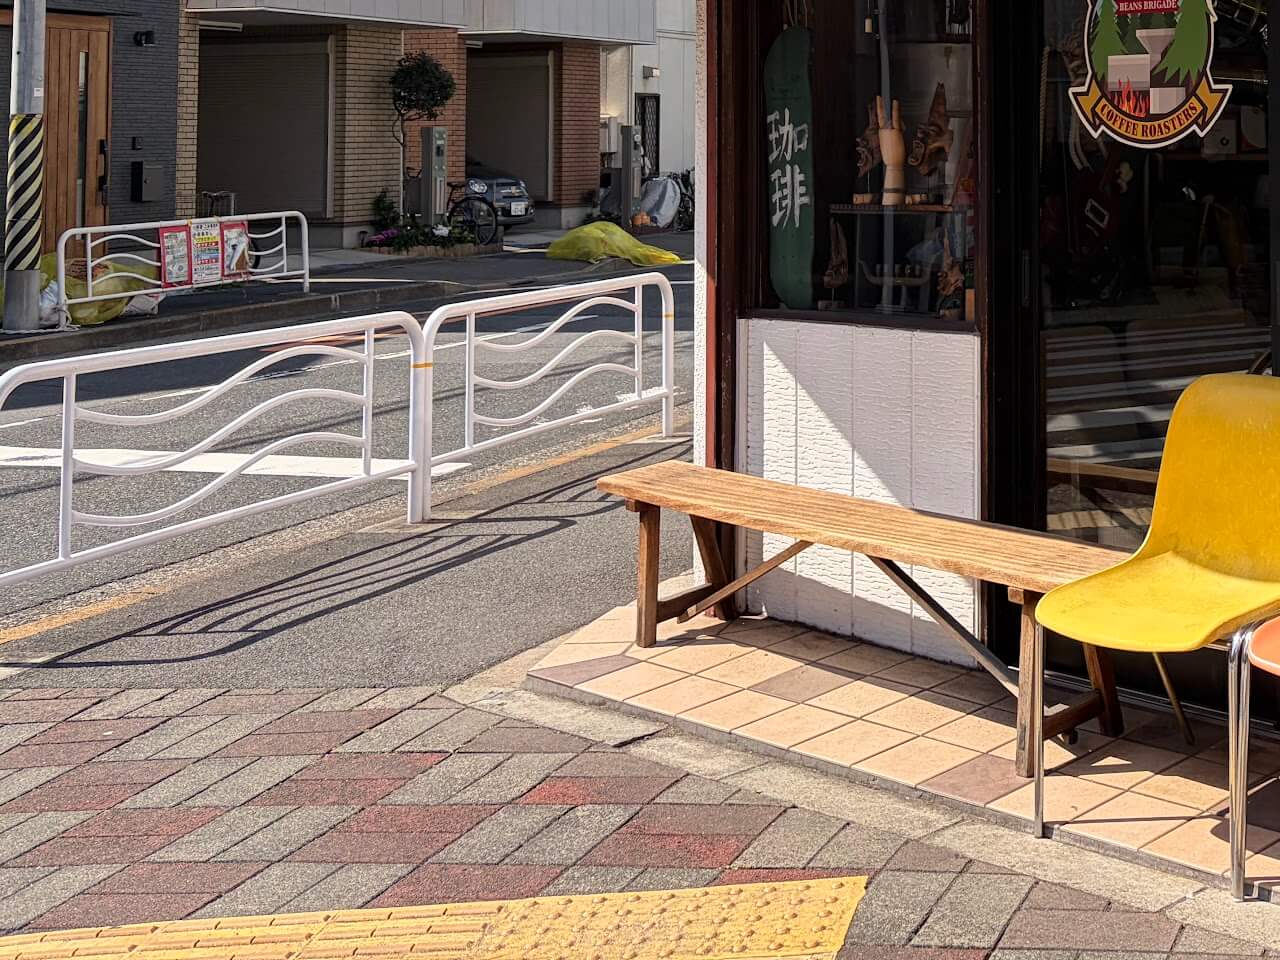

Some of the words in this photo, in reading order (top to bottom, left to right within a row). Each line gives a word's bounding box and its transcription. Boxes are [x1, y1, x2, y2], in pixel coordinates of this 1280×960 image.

[1119, 1, 1143, 12] BEANS
[1143, 0, 1178, 10] BRIGADE
[1100, 103, 1139, 136] COFFEE
[1141, 102, 1198, 137] ROASTERS
[766, 107, 811, 230] 珈琲
